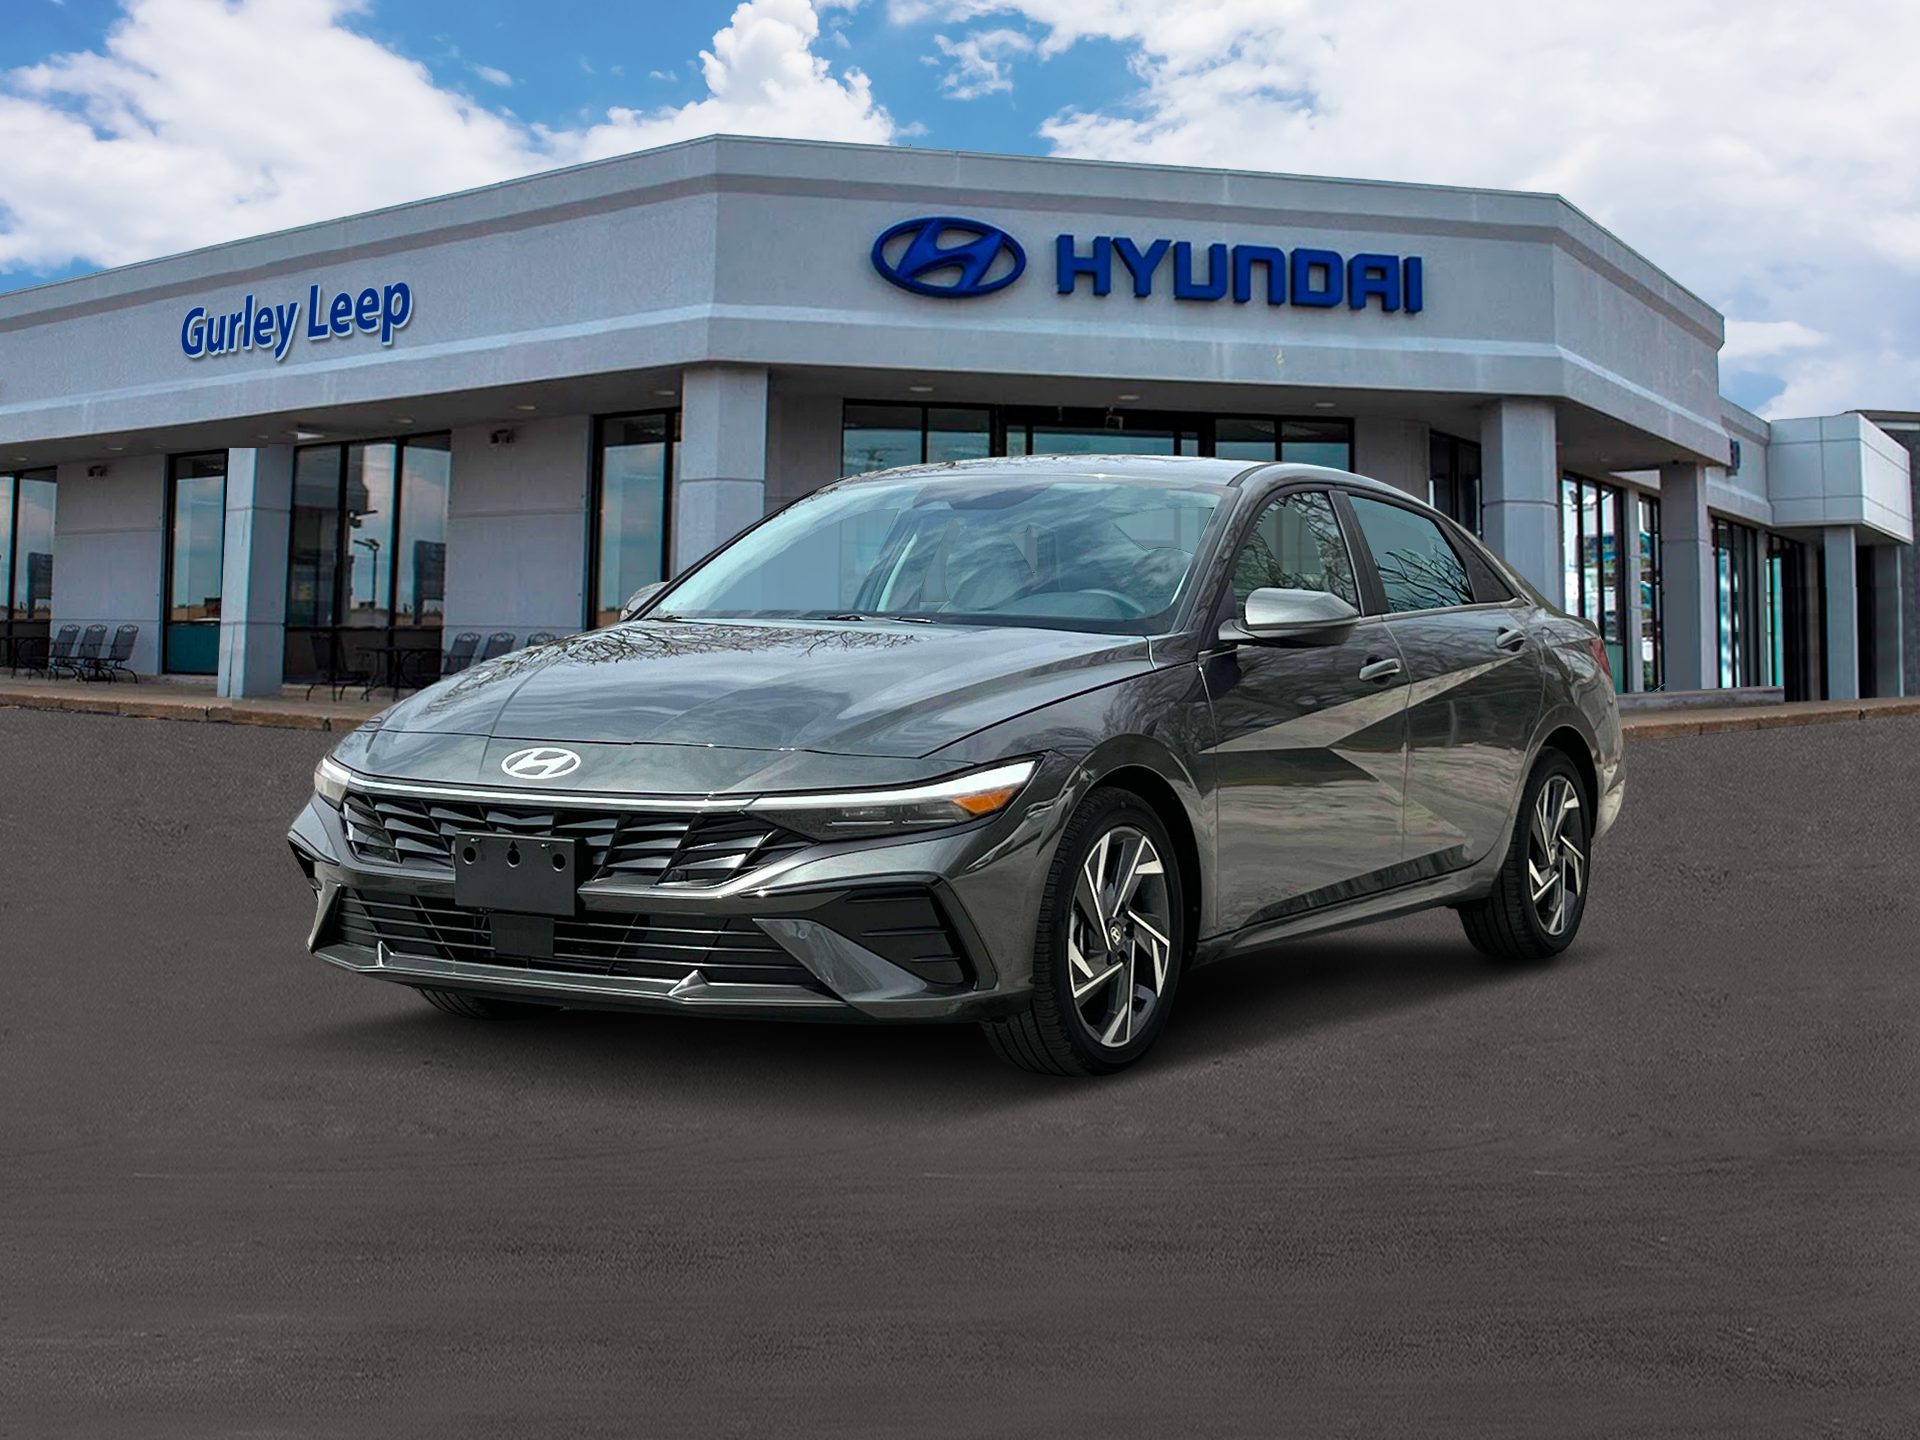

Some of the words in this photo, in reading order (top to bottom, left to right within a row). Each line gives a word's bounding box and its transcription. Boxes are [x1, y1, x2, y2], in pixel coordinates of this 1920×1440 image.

[1056, 234, 1423, 314] HYUNDAI
[181, 294, 299, 361] Gurley
[307, 282, 412, 346] Leep
